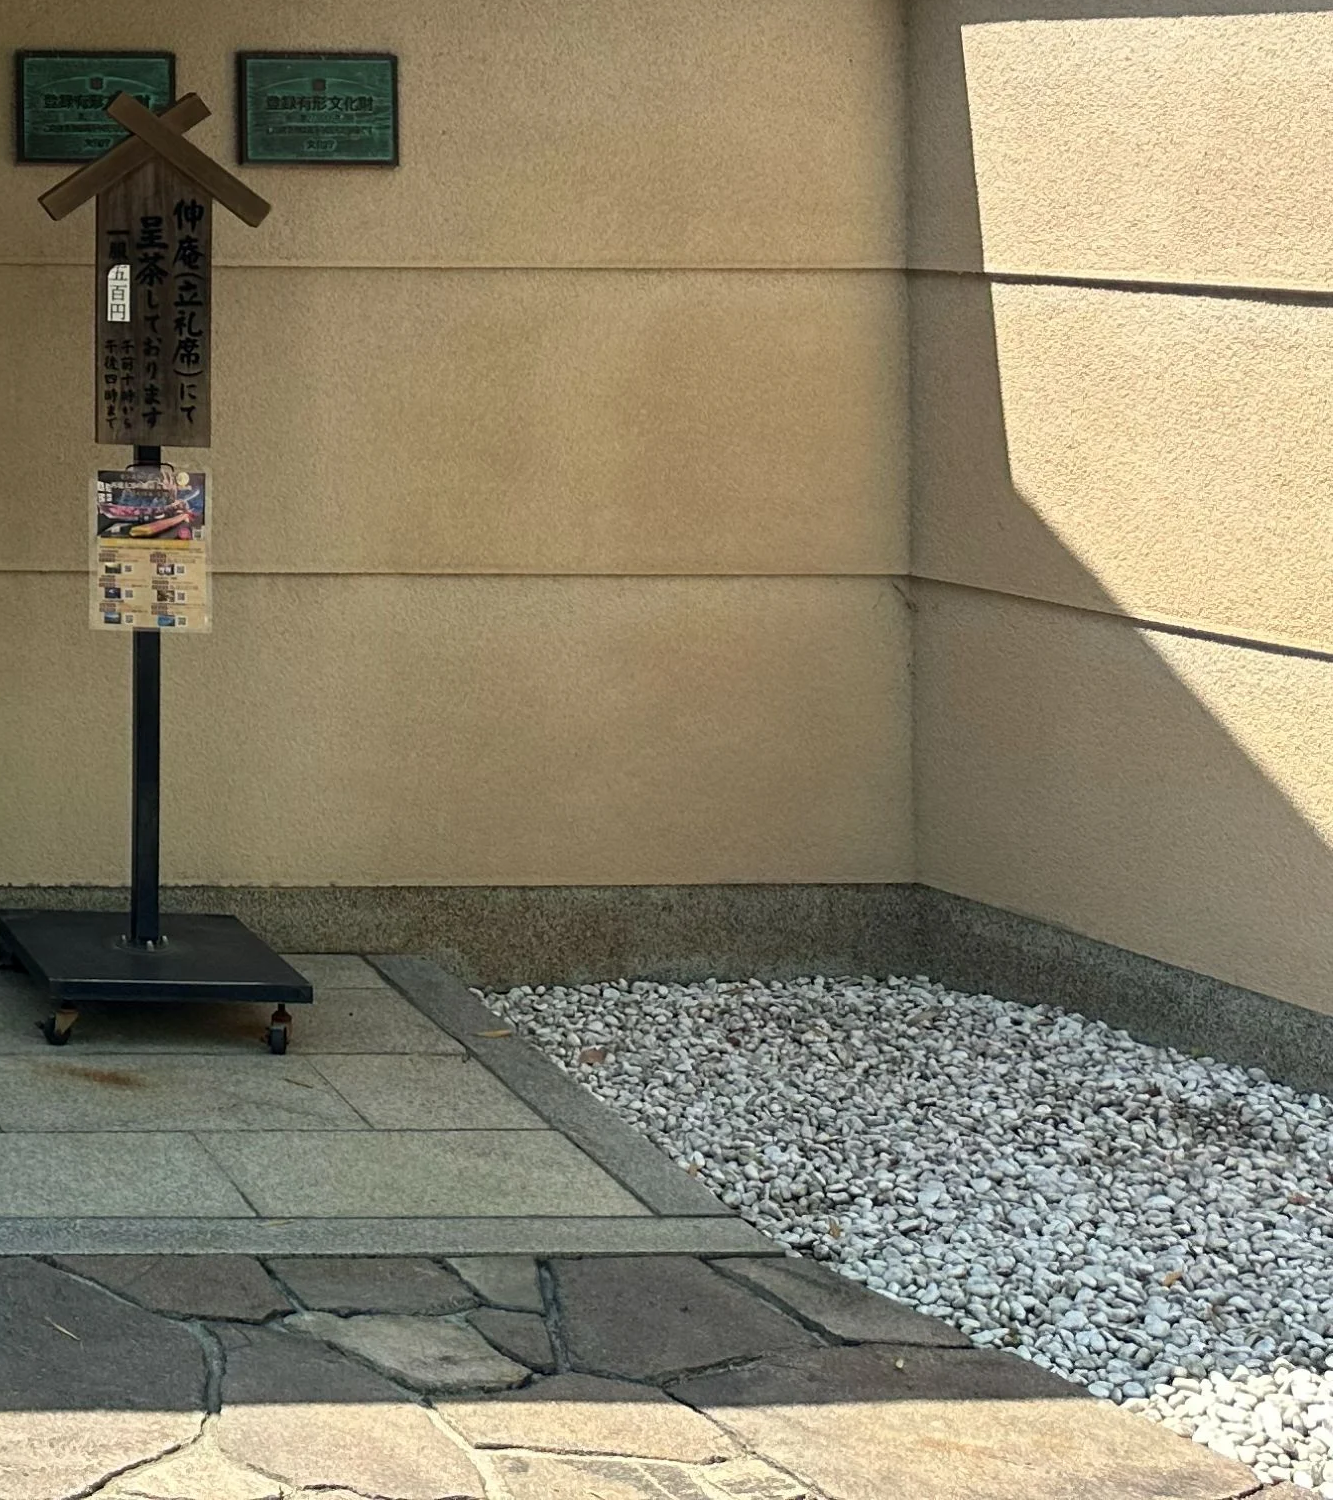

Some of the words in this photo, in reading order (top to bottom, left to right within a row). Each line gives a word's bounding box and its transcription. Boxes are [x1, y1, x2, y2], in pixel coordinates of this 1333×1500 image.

[266, 95, 373, 111] 登録有形文化財
[107, 228, 130, 260] 一服
[109, 266, 130, 321] 五百円
[136, 216, 169, 429] 呈茶しております
